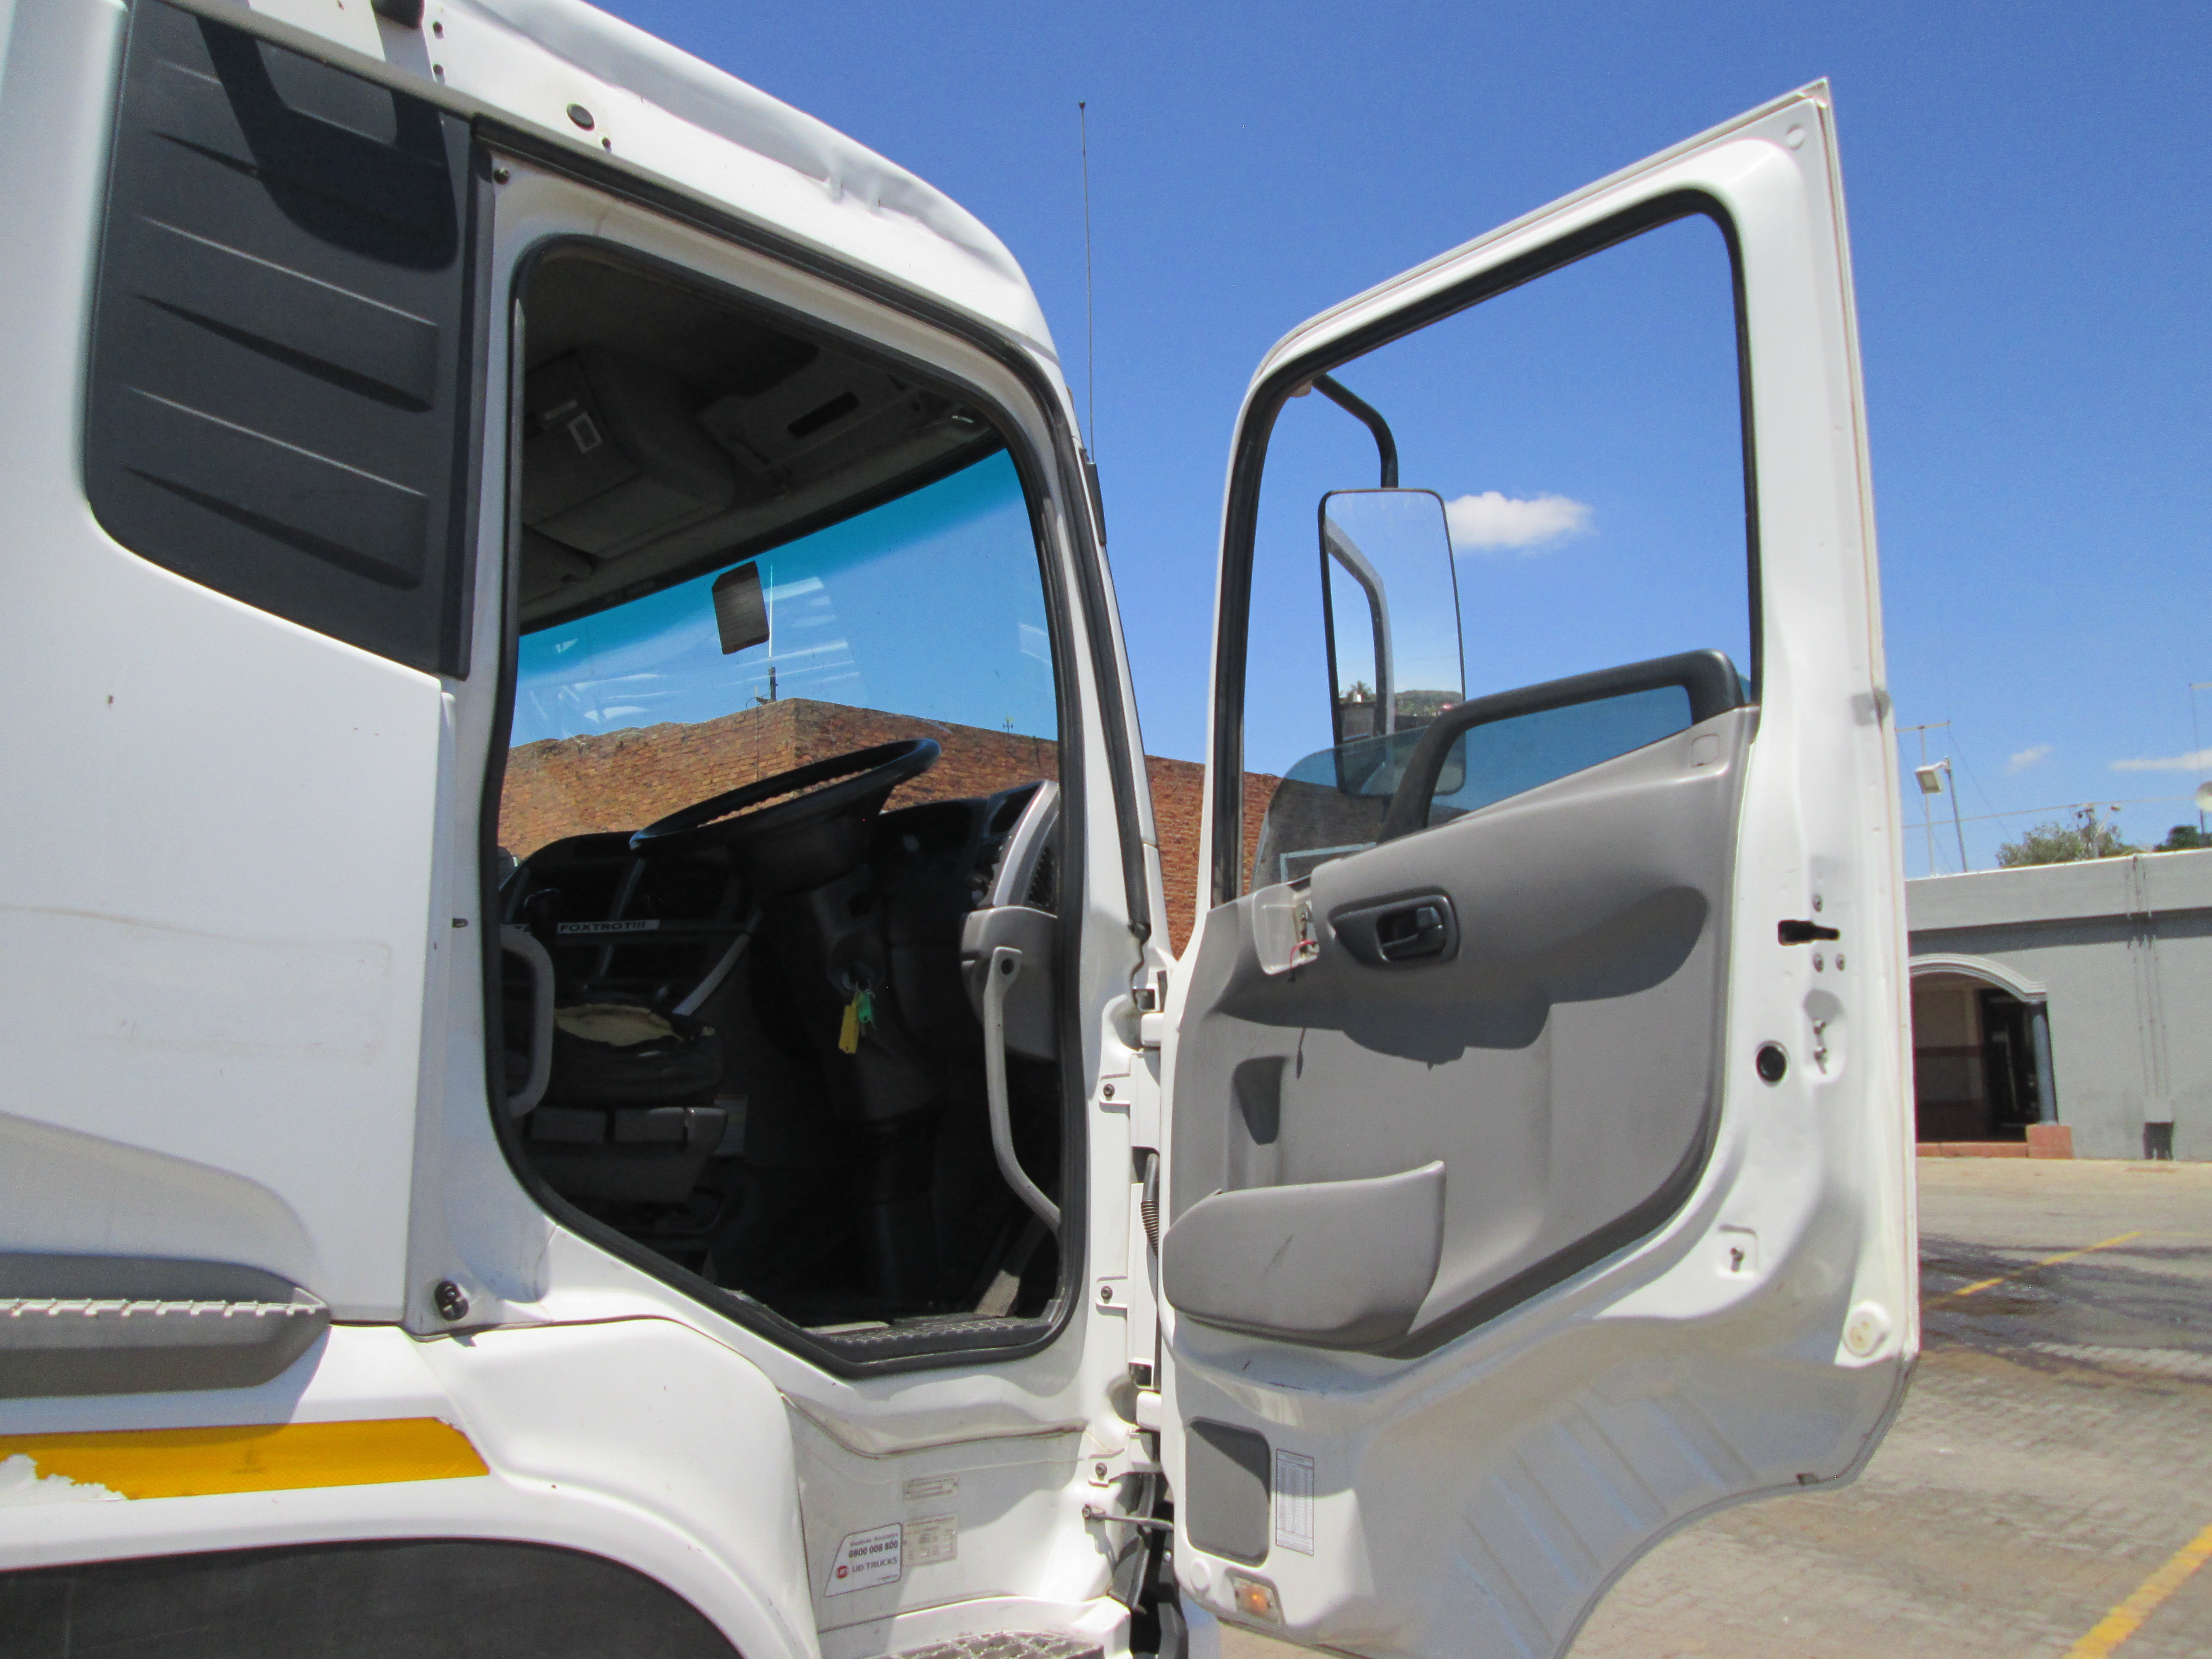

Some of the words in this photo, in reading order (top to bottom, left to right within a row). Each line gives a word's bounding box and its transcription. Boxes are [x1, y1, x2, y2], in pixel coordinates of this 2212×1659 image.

[848, 1547, 867, 1558] 0800
[884, 1540, 898, 1551] 800
[852, 1564, 864, 1573] UD
[866, 1557, 897, 1569] TRUCKS
